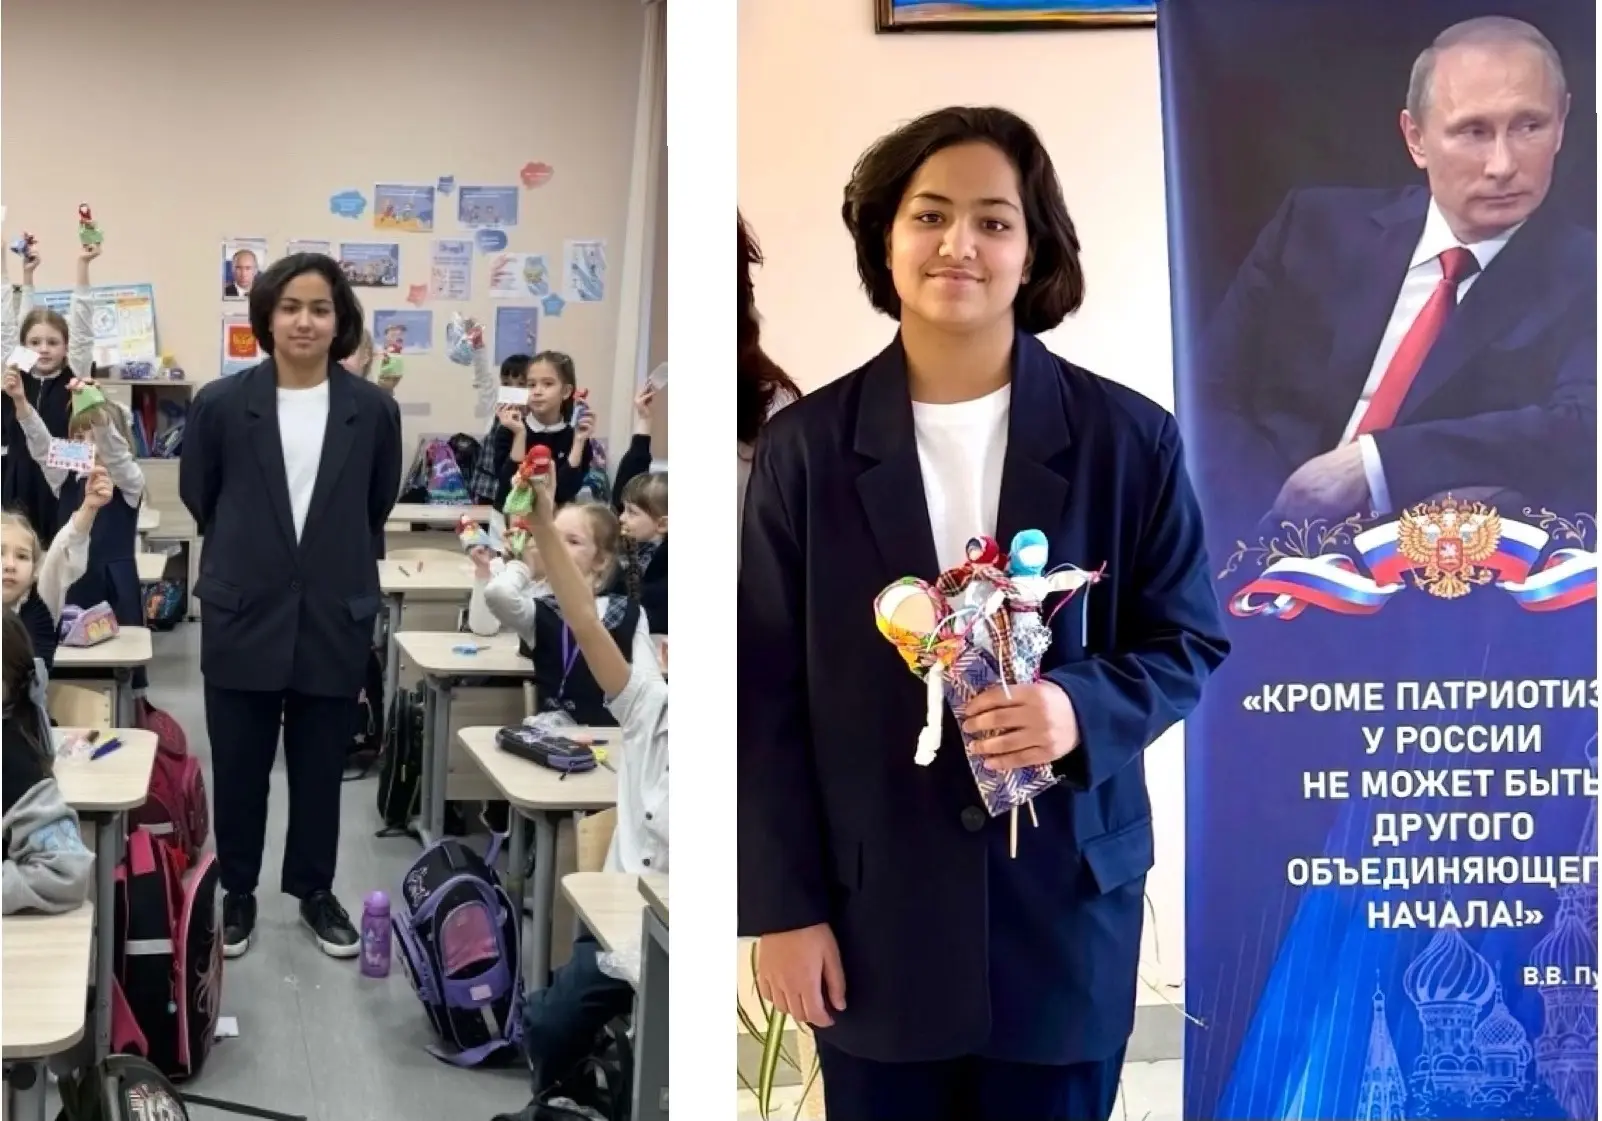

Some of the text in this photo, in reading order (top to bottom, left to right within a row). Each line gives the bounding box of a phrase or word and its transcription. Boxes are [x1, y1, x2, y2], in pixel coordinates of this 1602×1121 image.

[1243, 682, 1385, 713] «КРОМЕ
[1361, 724, 1542, 754] У РОССИИ
[1303, 768, 1598, 799] НЕ МОЖЕТ БЫТЬ
[1372, 811, 1534, 847] ДРУГОГО
[1287, 855, 1598, 889] ОБЪЕДИНЯЮЩЕГ
[1368, 900, 1543, 929] НАЧАЛА!»
[1523, 966, 1568, 986] В.В.
